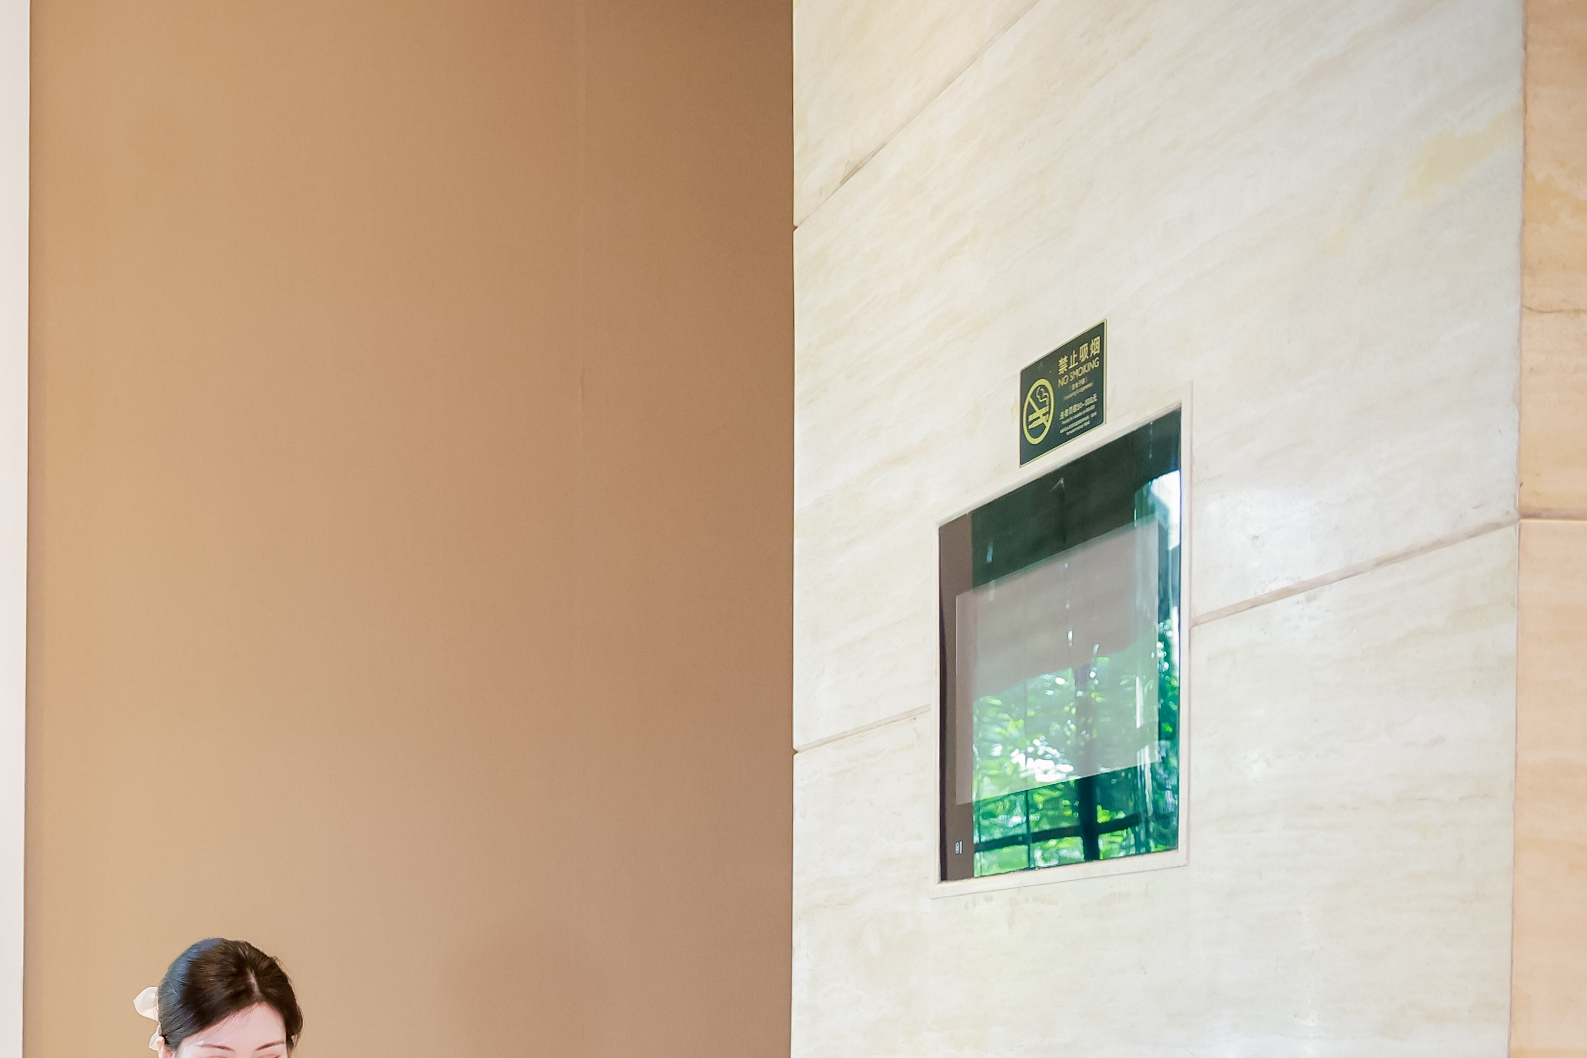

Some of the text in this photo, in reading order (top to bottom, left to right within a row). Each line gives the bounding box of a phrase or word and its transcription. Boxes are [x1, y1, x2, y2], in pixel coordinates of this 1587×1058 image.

[1058, 335, 1101, 375] 禁止吸烟
[1057, 358, 1100, 388] NO SMOKING
